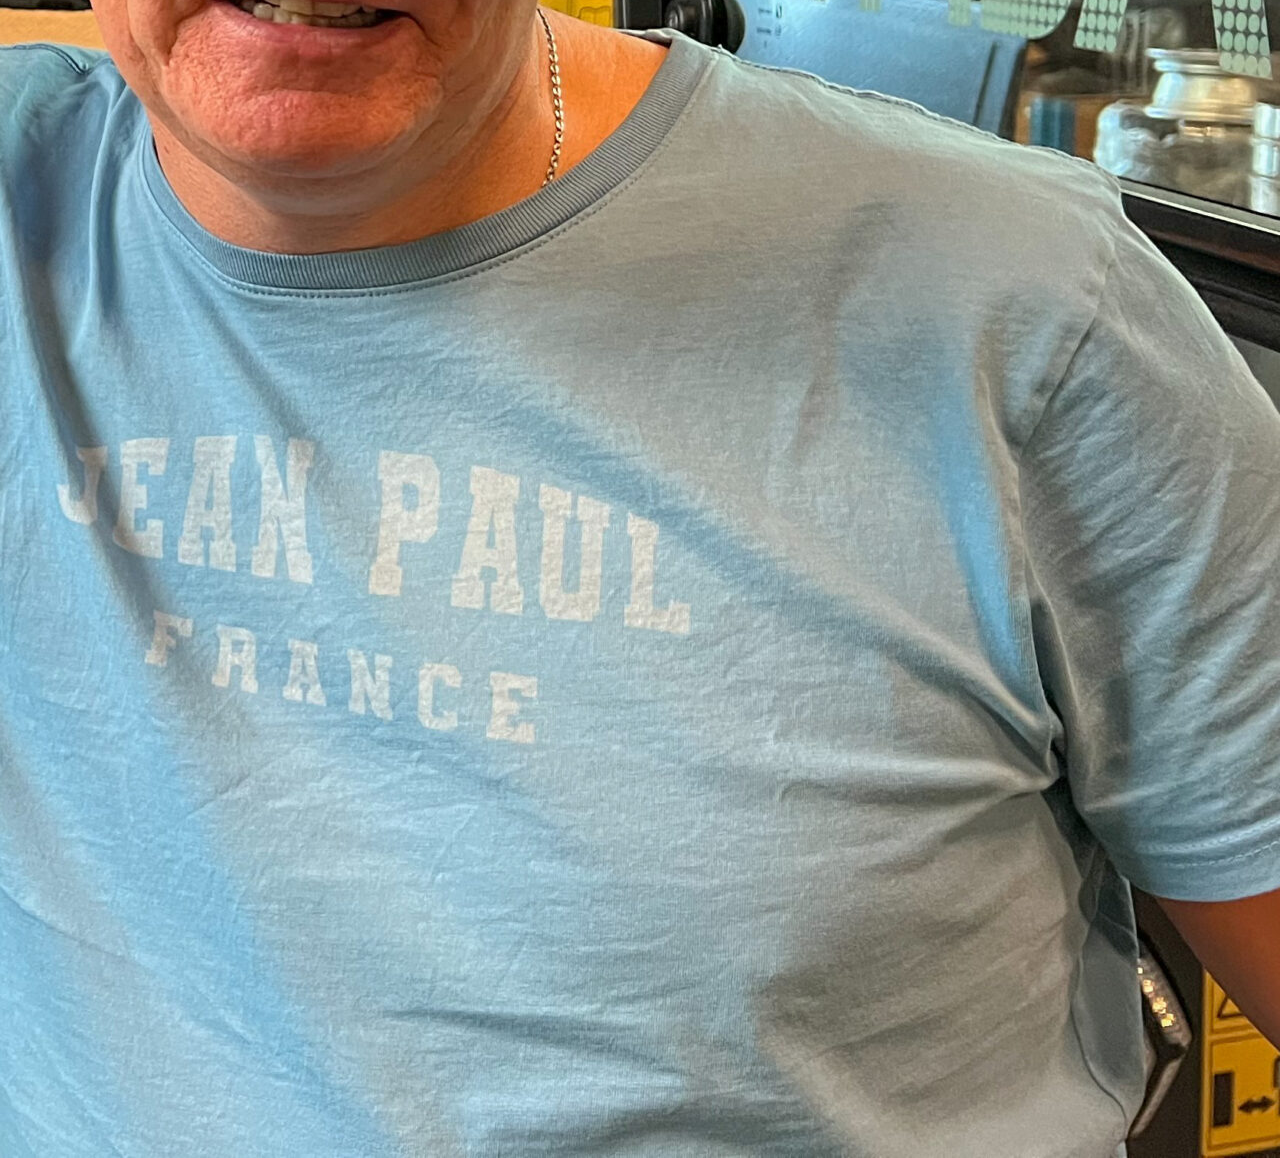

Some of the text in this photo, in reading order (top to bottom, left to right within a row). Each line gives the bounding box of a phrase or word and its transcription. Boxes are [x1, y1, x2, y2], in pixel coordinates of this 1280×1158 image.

[56, 435, 692, 635] JEAN PAUL
[143, 609, 539, 743] FRANCE
